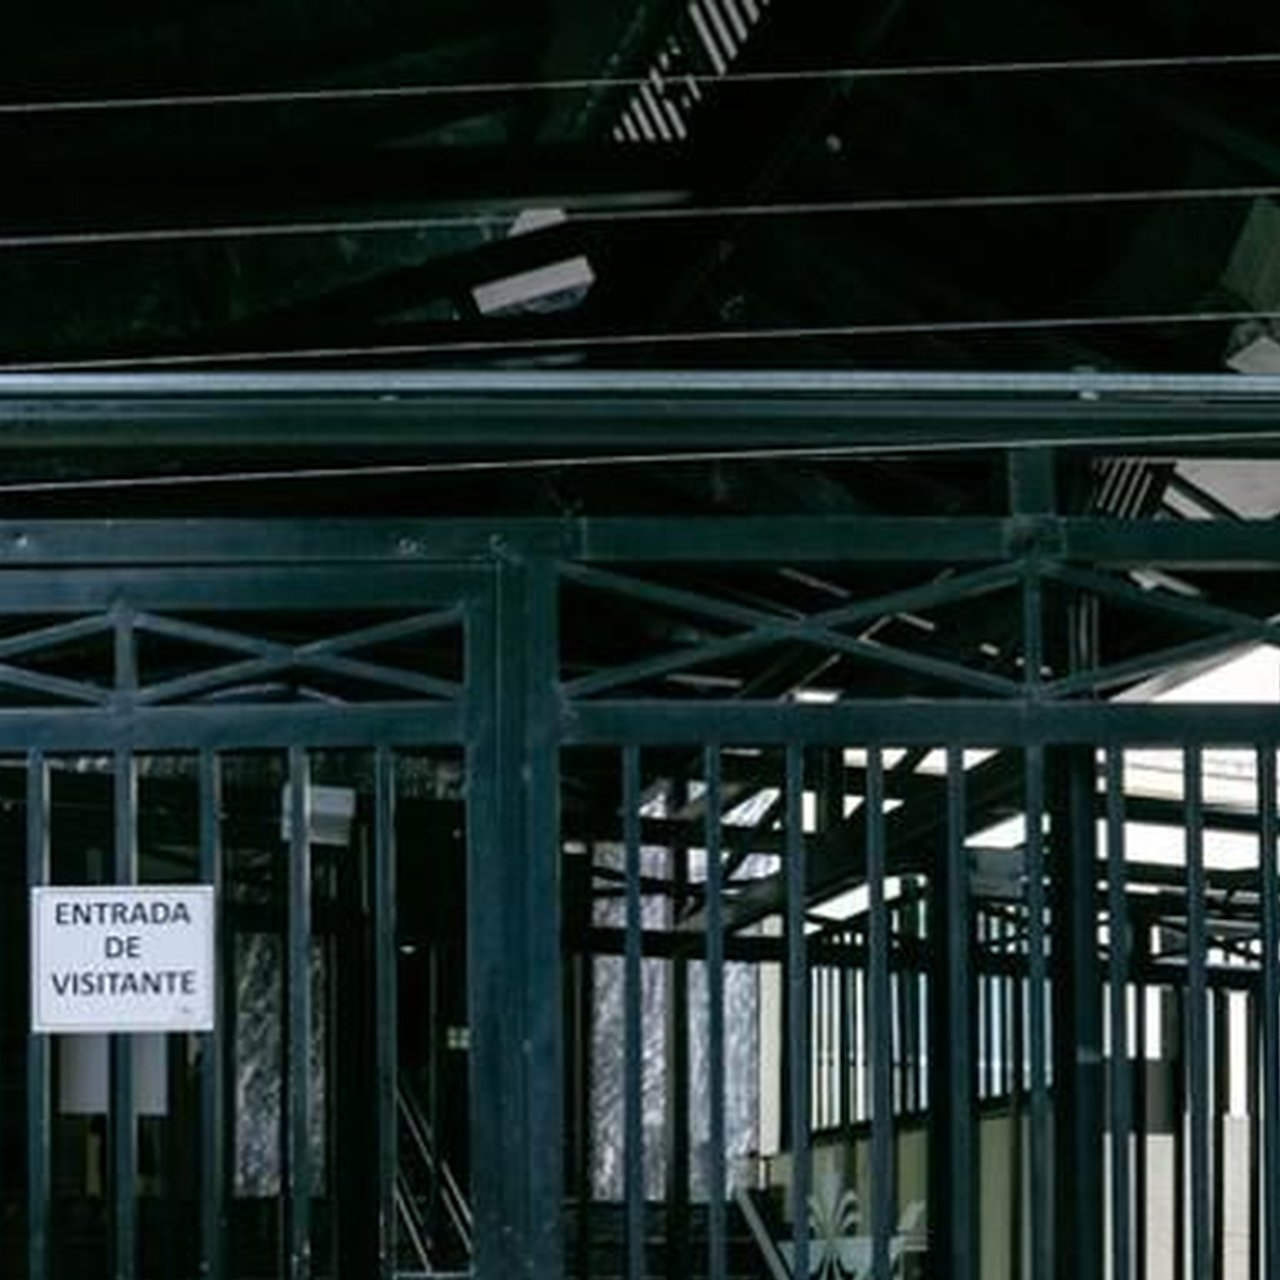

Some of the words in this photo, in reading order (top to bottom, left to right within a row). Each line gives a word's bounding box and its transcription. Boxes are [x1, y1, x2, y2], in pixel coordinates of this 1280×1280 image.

[55, 902, 192, 925] ENTRADA
[105, 936, 141, 958] DE
[52, 970, 197, 996] VISITANTE
